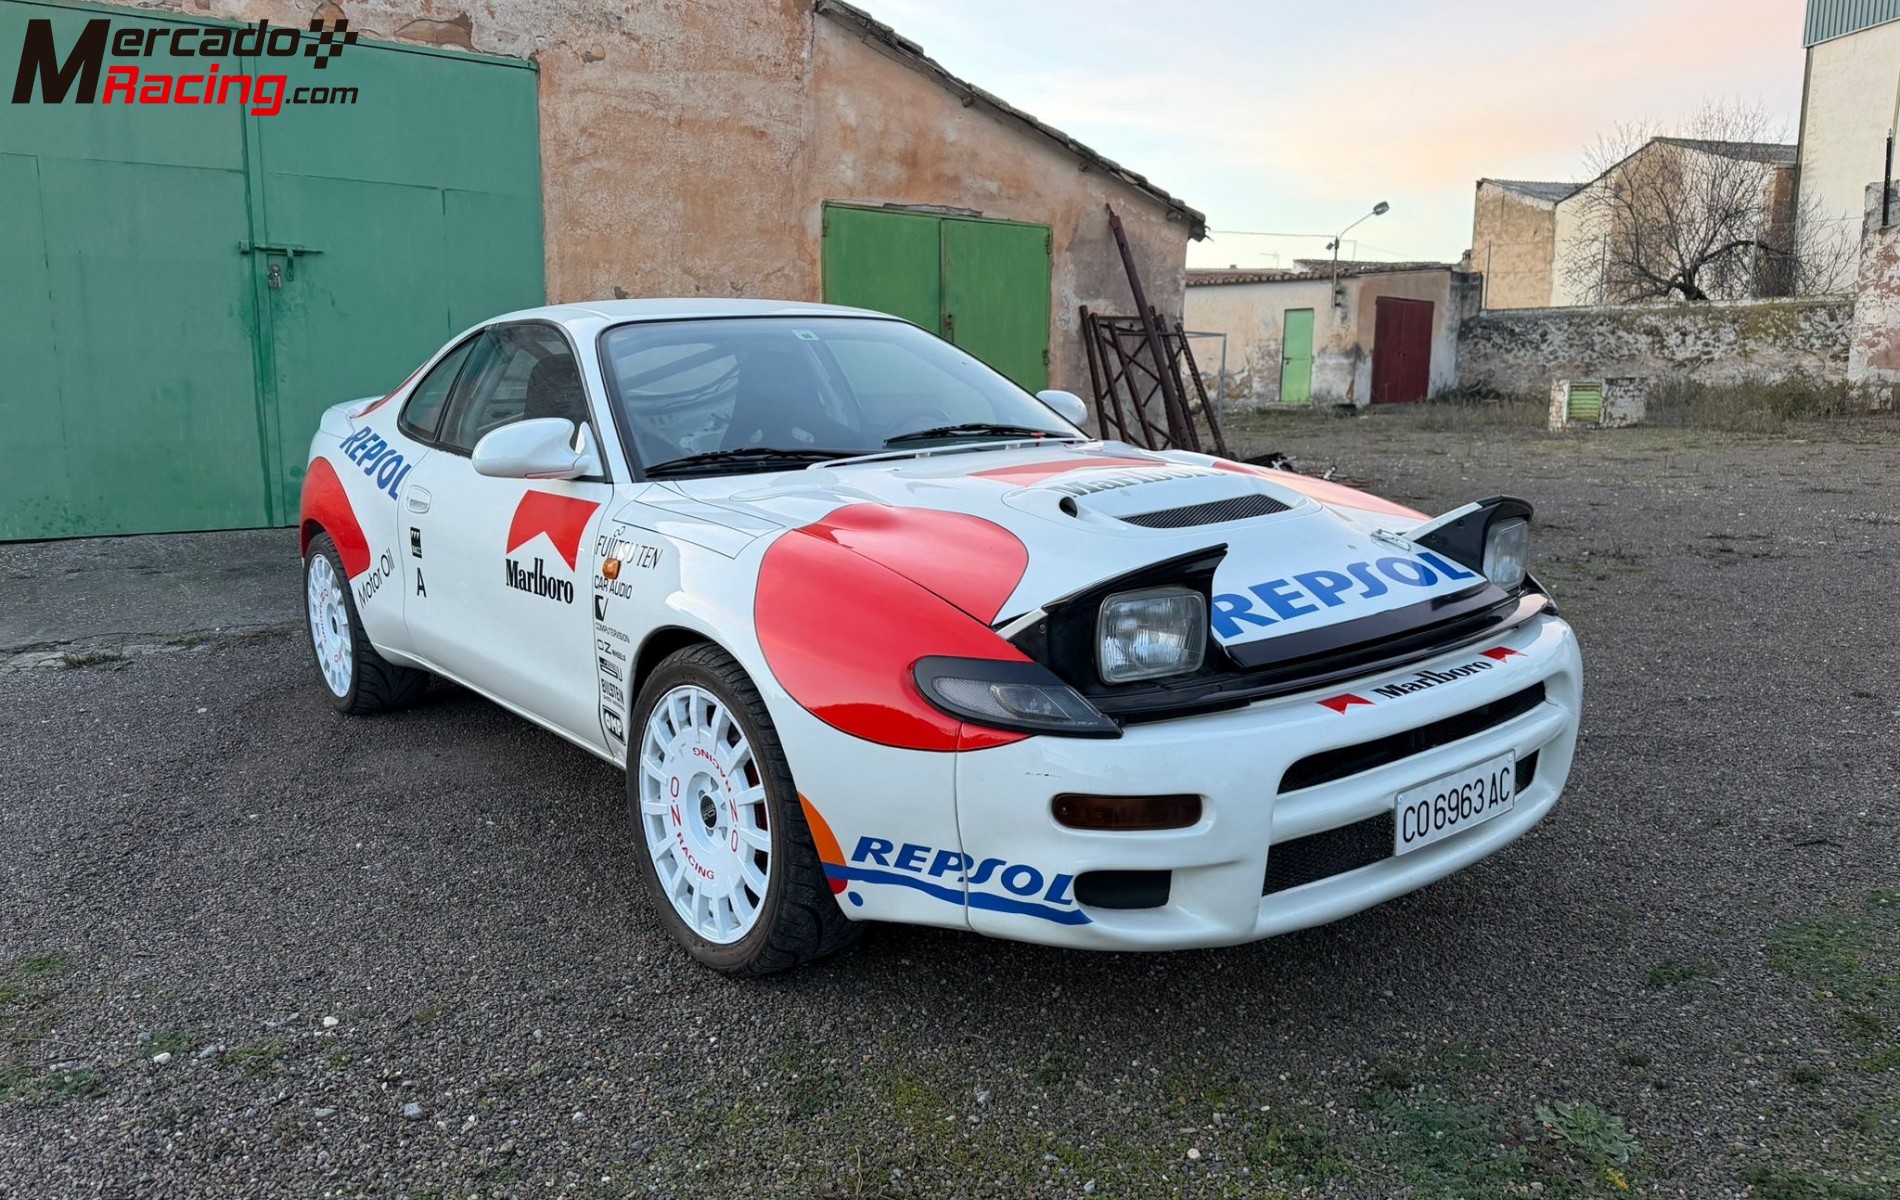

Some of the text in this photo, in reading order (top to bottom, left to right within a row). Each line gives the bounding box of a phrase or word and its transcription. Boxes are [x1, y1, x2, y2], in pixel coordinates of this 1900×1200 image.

[339, 426, 412, 501] REPSOL
[357, 547, 396, 610] Motor Oil
[416, 566, 427, 599] A
[505, 556, 574, 605] Marlboro
[637, 545, 664, 571] TEN
[594, 574, 633, 600] CAR AUDIO
[1211, 552, 1476, 640] REPSOL
[1370, 659, 1494, 699] Marlboro
[1433, 778, 1485, 830] 6963
[1488, 766, 1511, 810] AC
[677, 832, 715, 880] RACING
[851, 836, 1074, 906] REPSOL
